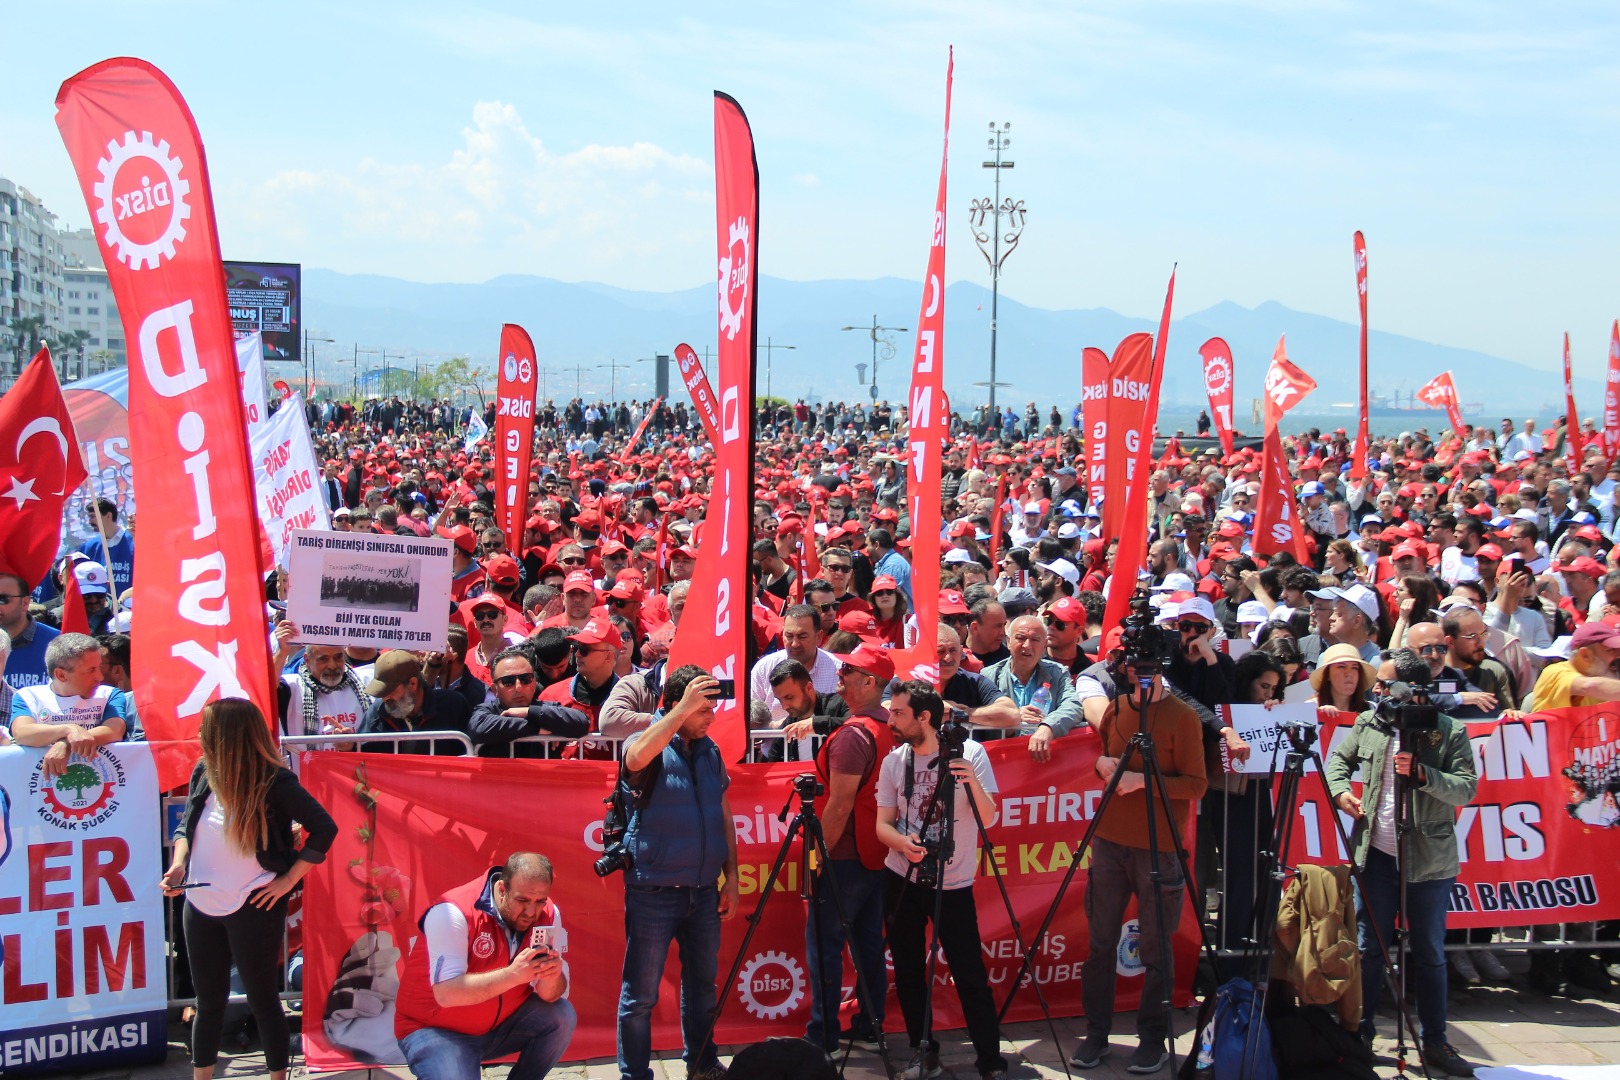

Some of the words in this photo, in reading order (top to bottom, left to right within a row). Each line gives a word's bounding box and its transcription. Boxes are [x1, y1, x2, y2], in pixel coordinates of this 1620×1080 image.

[298, 536, 323, 549] TARİŞ
[325, 538, 365, 552] DİRENİŞİ
[366, 541, 405, 554] SINIFSAL
[406, 545, 448, 557] ONURDUR
[354, 614, 371, 625] YEK
[372, 615, 401, 627] GULAN
[302, 624, 340, 636] YAŞASIN
[342, 627, 346, 637] 1
[348, 627, 376, 639] MAYIS
[377, 628, 403, 642] TARİŞ
[28, 772, 40, 795] TÜM
[37, 806, 77, 831] KONAK
[81, 800, 120, 831] ŞUBESİ
[1299, 801, 1322, 858] 1
[1475, 874, 1599, 912] BAROSU
